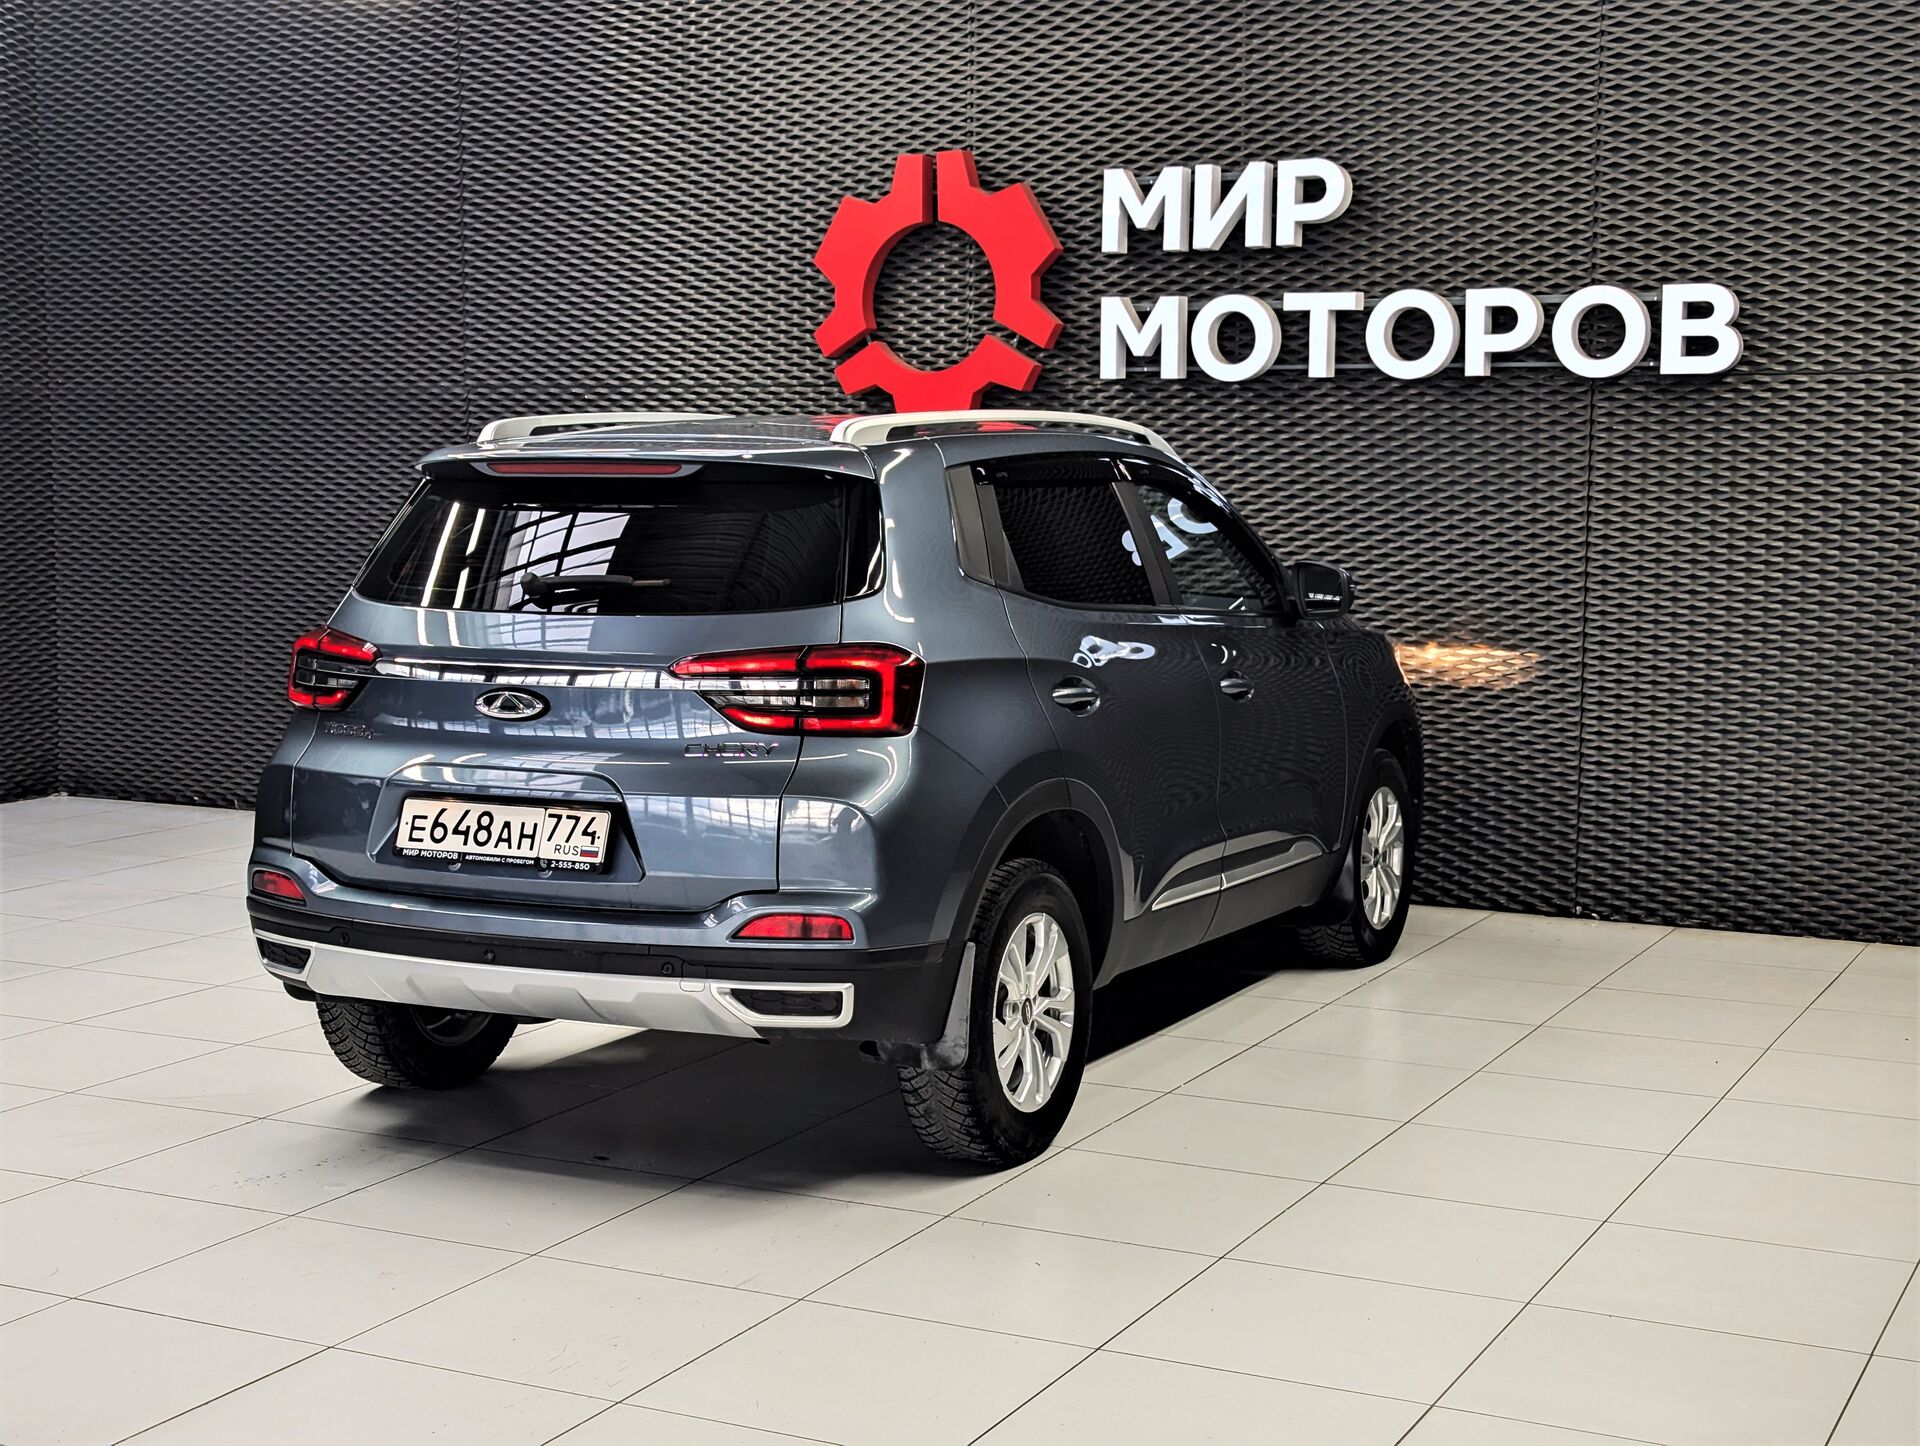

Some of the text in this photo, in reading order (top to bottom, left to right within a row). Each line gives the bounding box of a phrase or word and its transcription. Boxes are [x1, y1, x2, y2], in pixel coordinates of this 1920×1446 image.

[1101, 157, 1353, 254] МИР
[1099, 283, 1744, 382] МОТОРОВ
[684, 742, 779, 758] CHERY
[407, 807, 597, 852] Е648АН 774
[402, 848, 420, 857] МИР
[420, 850, 459, 860] МОТОРОВ
[464, 854, 500, 864] АВТОМОБИЛИ
[506, 857, 535, 866] ПРОБЕГОМ
[550, 860, 590, 871] 2-555-850
[553, 843, 580, 856] RUS
